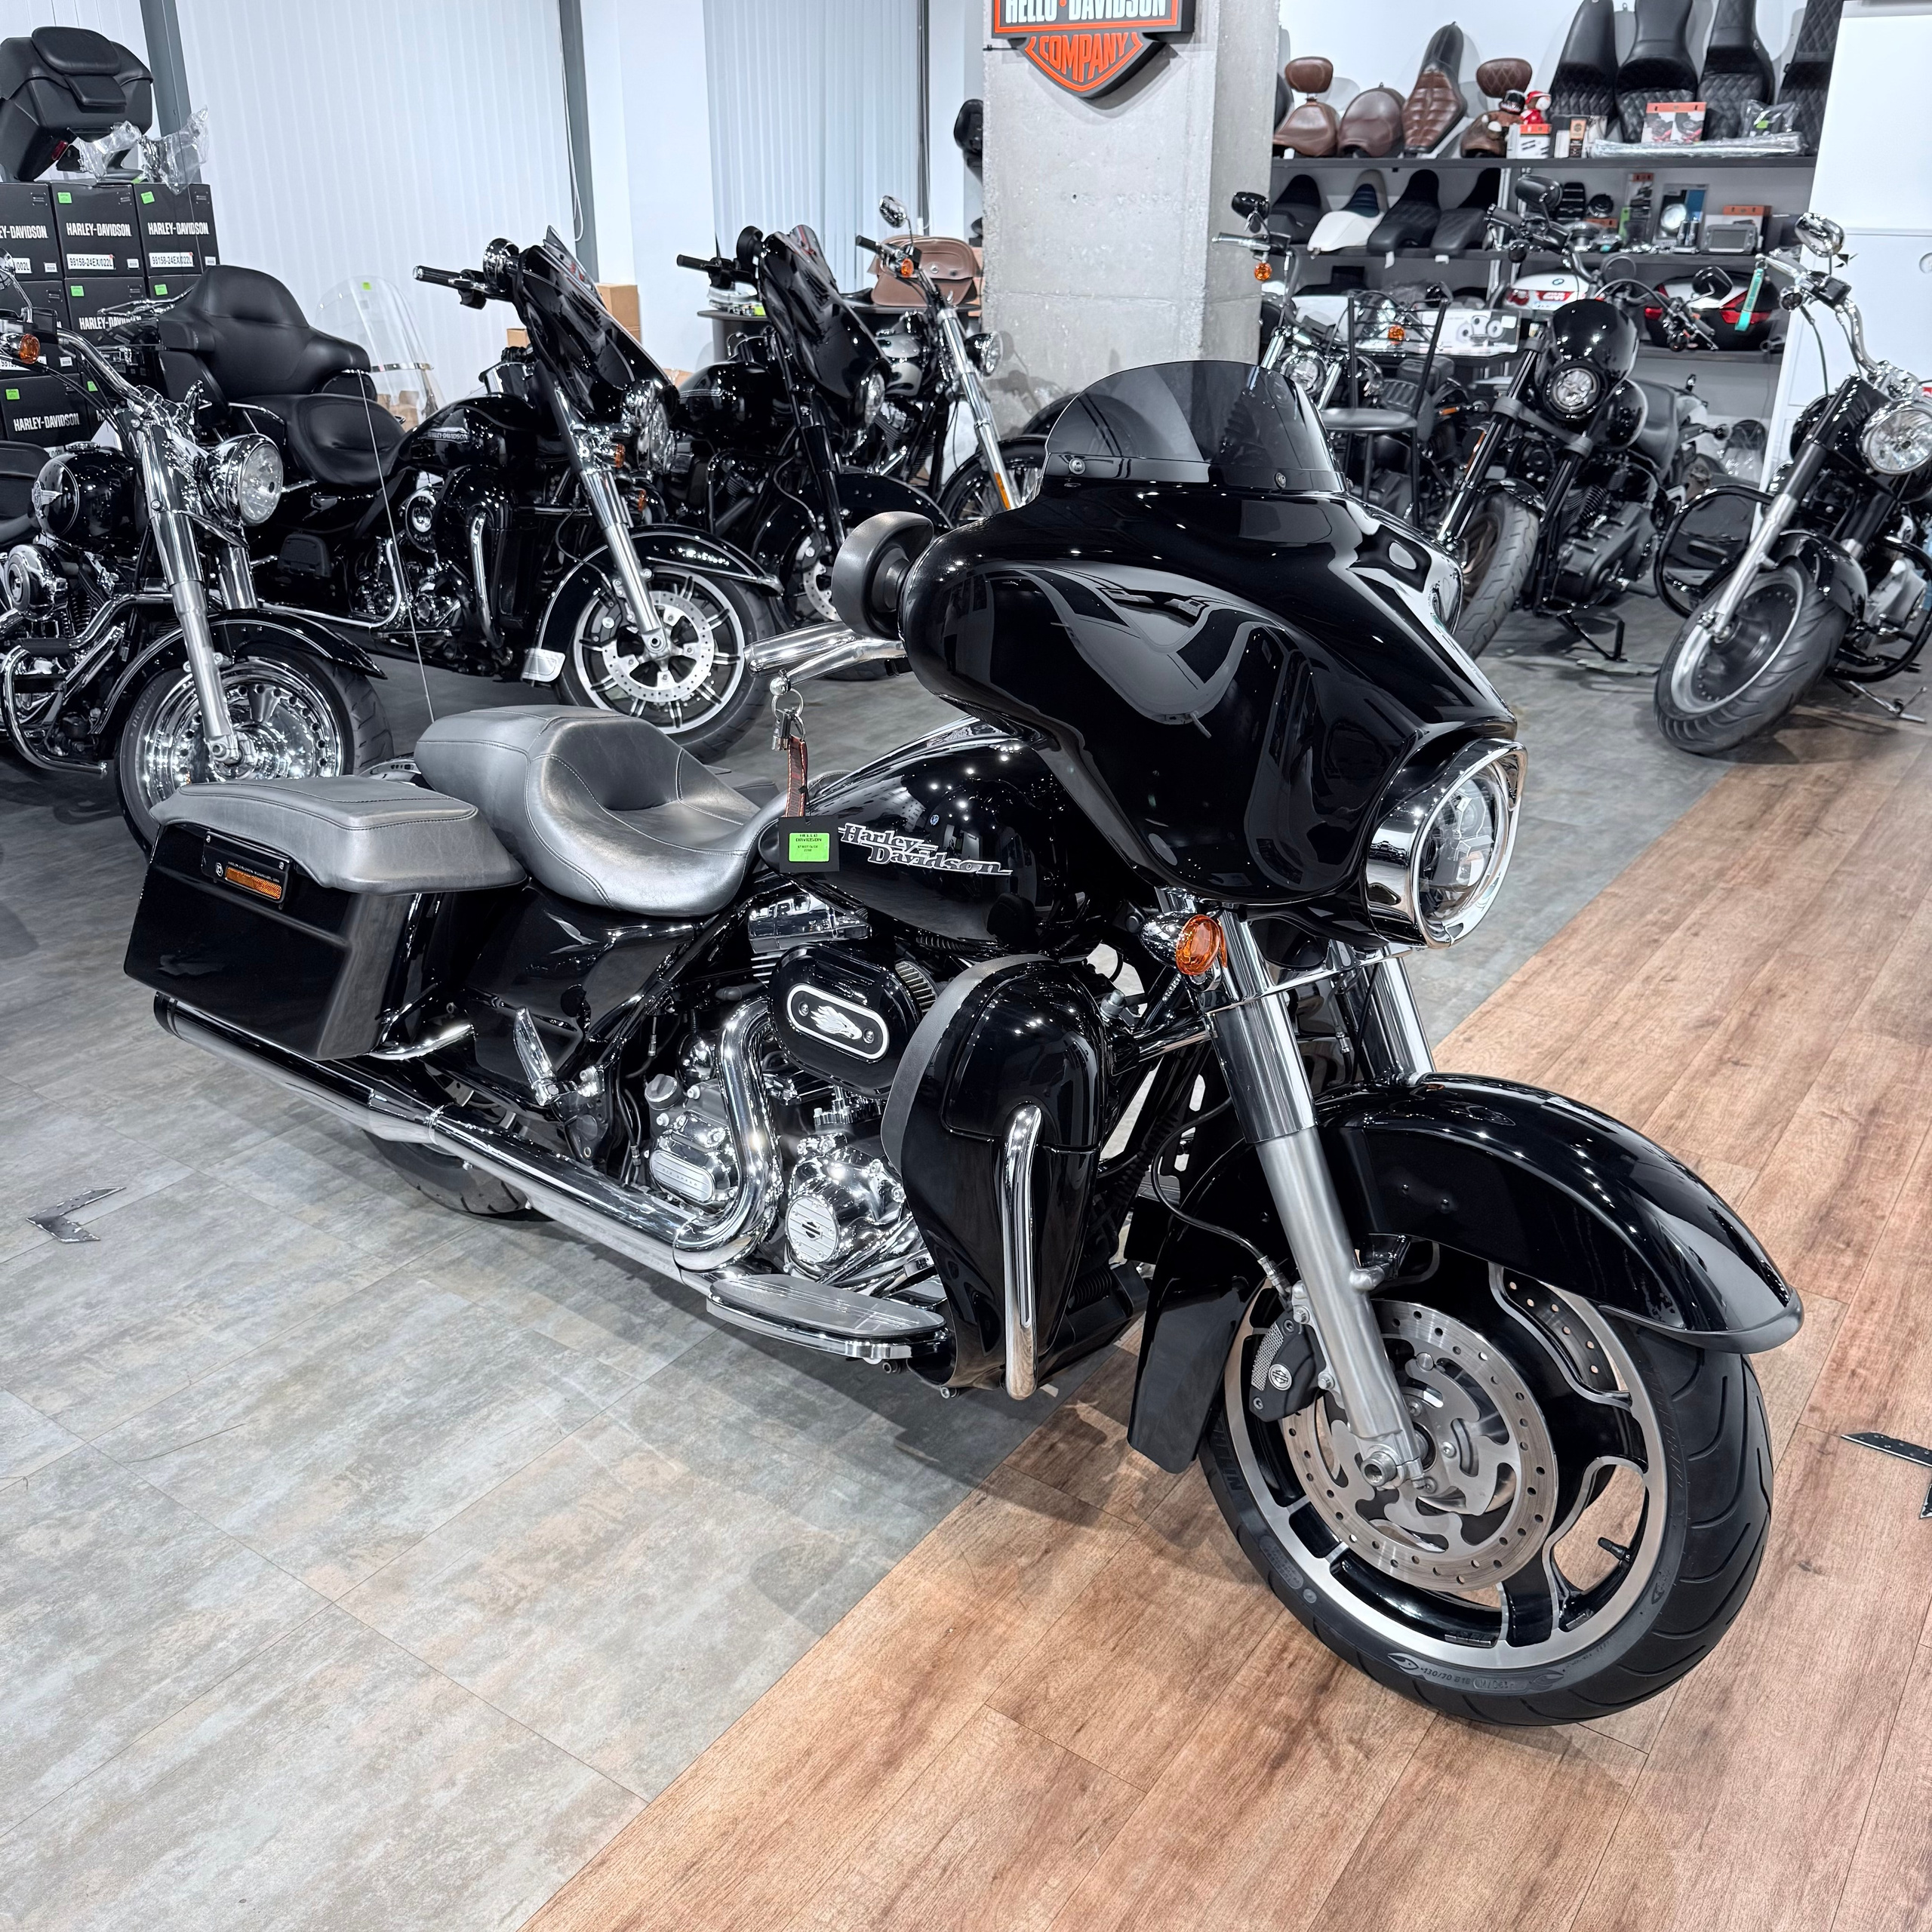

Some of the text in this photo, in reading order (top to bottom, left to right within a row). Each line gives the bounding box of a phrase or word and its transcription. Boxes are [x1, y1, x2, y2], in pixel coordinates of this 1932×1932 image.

[1005, 0, 1165, 23] HELLO DAVIDSON
[1039, 32, 1128, 82] COMPANY
[66, 222, 131, 237] HARLEY-DAVIDSON
[148, 222, 209, 235] HARLEY-DAVIDSON
[14, 412, 80, 432] HARLEY-DAVIDSON
[838, 823, 938, 854] Harley
[868, 842, 1013, 875] Davidson
